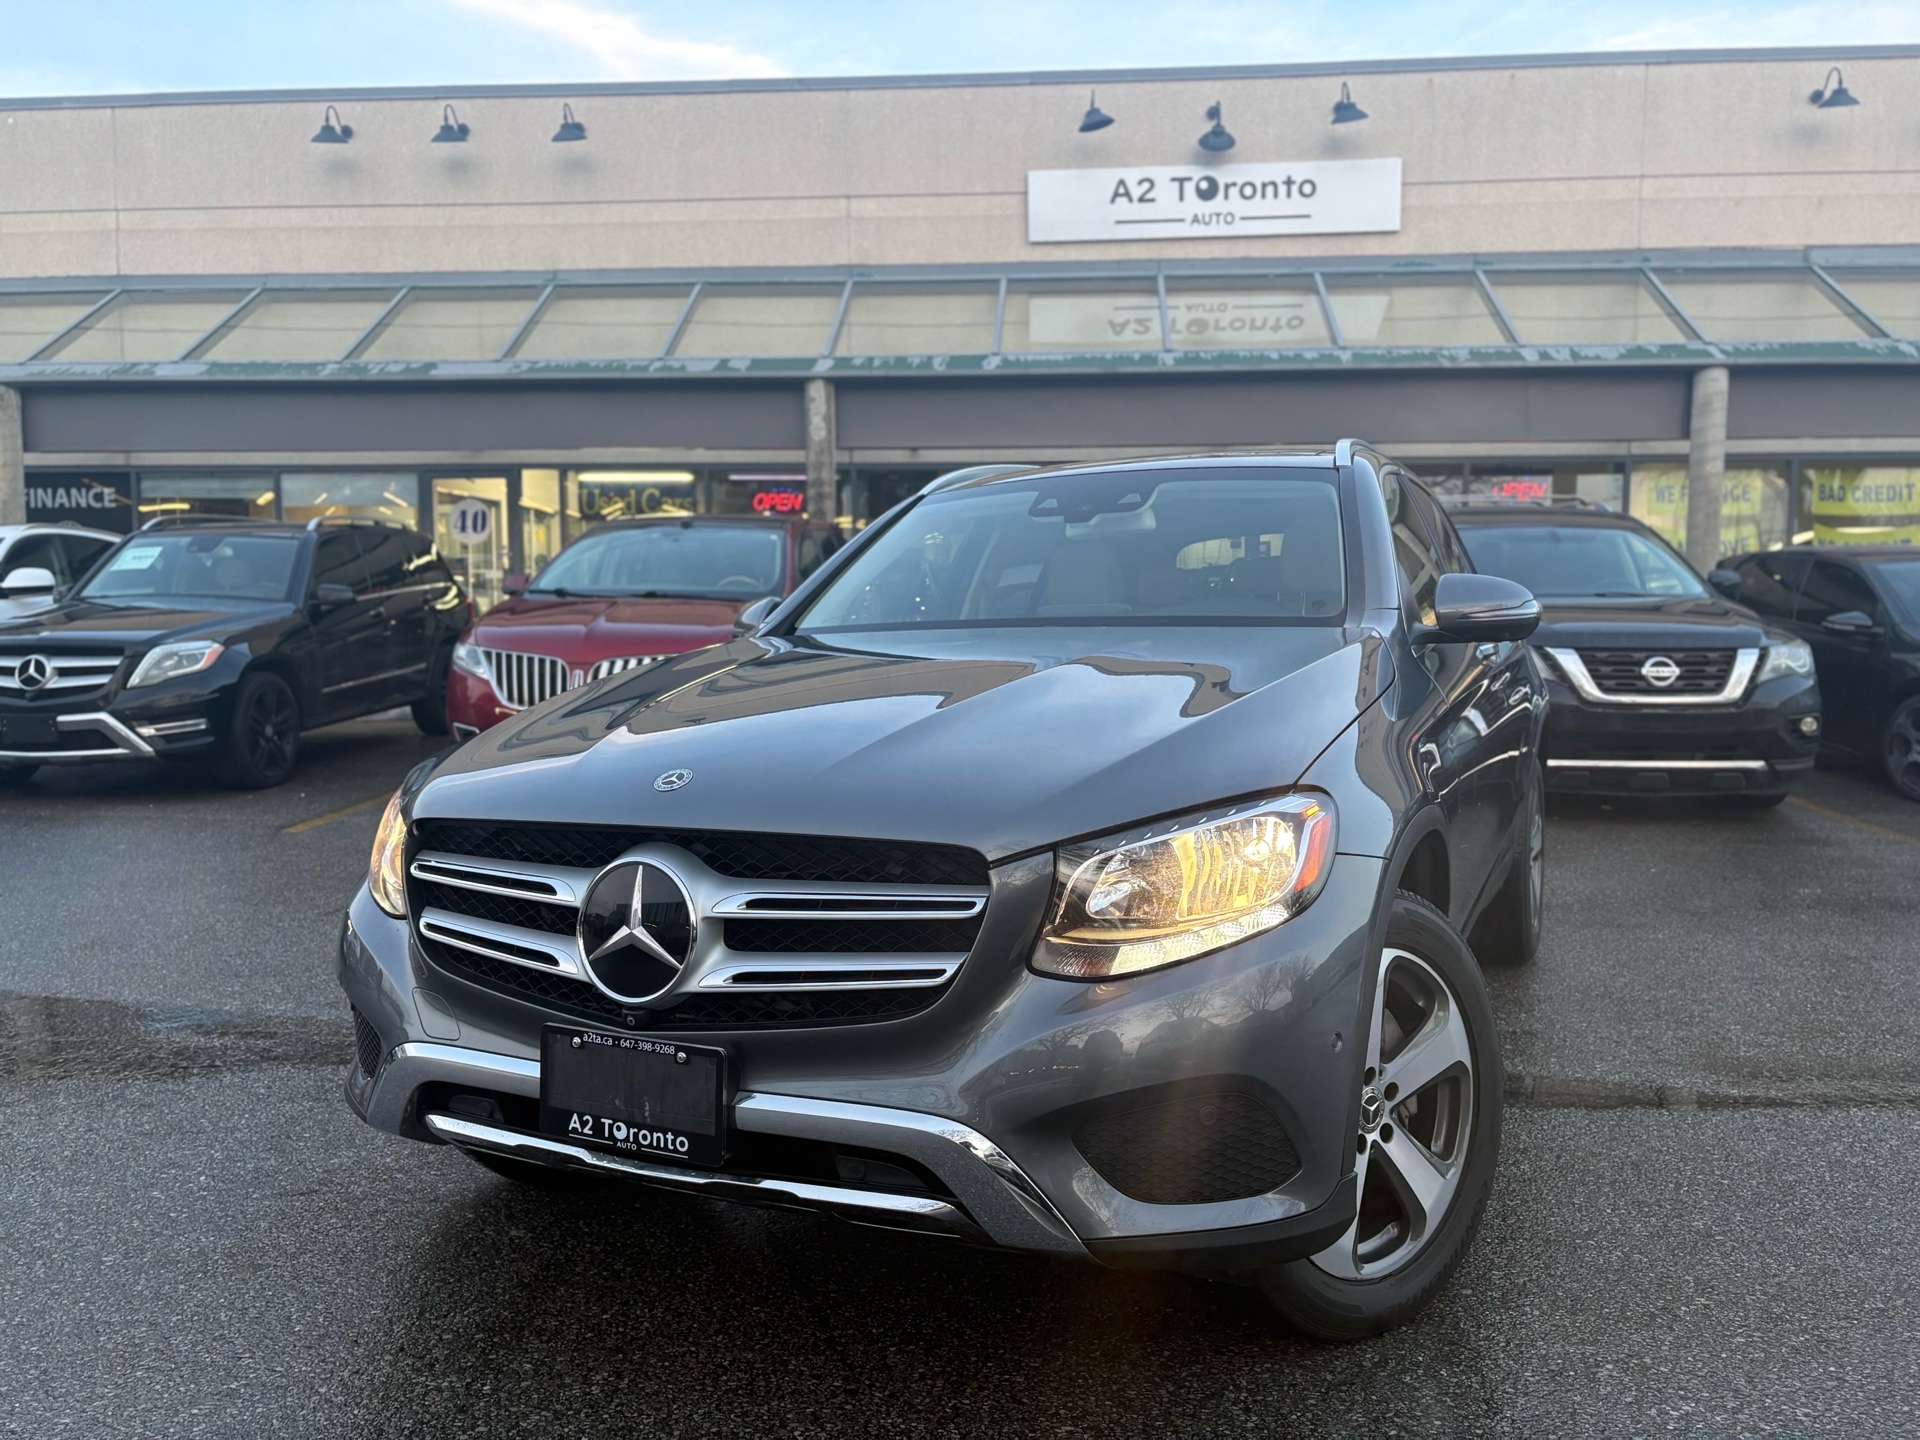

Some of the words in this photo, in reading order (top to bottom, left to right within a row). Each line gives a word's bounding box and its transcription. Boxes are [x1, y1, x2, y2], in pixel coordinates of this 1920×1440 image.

[1110, 177, 1156, 204] A2
[1170, 175, 1317, 203] Toronto
[1190, 212, 1235, 226] AUTO
[583, 487, 636, 515] Used
[641, 487, 693, 514] Cars
[752, 492, 804, 511] OPEN
[1818, 483, 1846, 502] BAD
[1851, 483, 1916, 503] CREDIT
[453, 509, 487, 534] 40
[582, 1032, 613, 1046] a2ta.ca
[620, 1038, 675, 1055] 647-398-9268
[568, 1113, 593, 1135] A2
[600, 1118, 689, 1152] Toronto
[616, 1141, 637, 1151] AUTO
